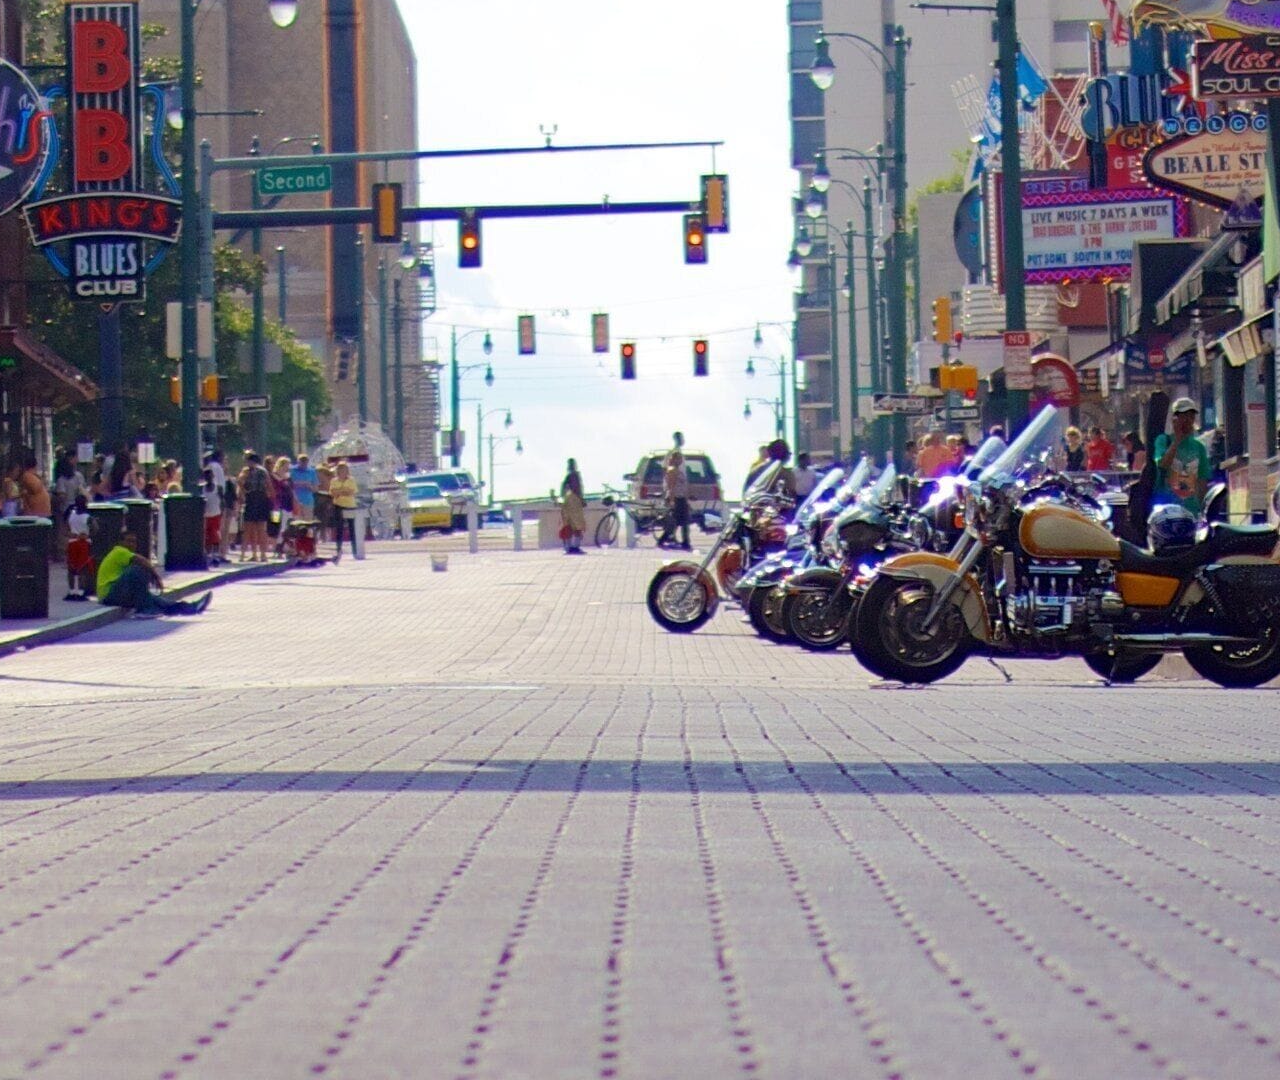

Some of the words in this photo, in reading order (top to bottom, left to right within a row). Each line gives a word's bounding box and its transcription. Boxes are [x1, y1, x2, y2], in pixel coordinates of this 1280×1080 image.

[1200, 40, 1275, 70] Miss
[1202, 76, 1261, 94] SOUL
[1163, 116, 1268, 134] WELCO
[1163, 153, 1231, 175] BEALE
[1239, 151, 1266, 171] ST
[263, 172, 326, 190] Second
[38, 199, 170, 233] KING'S
[1031, 212, 1052, 225] LIVE
[1057, 209, 1087, 222] MUSIC
[1090, 208, 1097, 220] 7
[1100, 206, 1127, 219] DAYS
[1130, 206, 1138, 218] A
[1141, 204, 1169, 217] WEEK
[75, 242, 138, 277] BLUES
[1027, 254, 1043, 266] PUT
[1074, 250, 1101, 263] SOUTH
[1116, 248, 1132, 261] YOU
[76, 279, 138, 296] CLUB
[1007, 333, 1025, 345] NO
